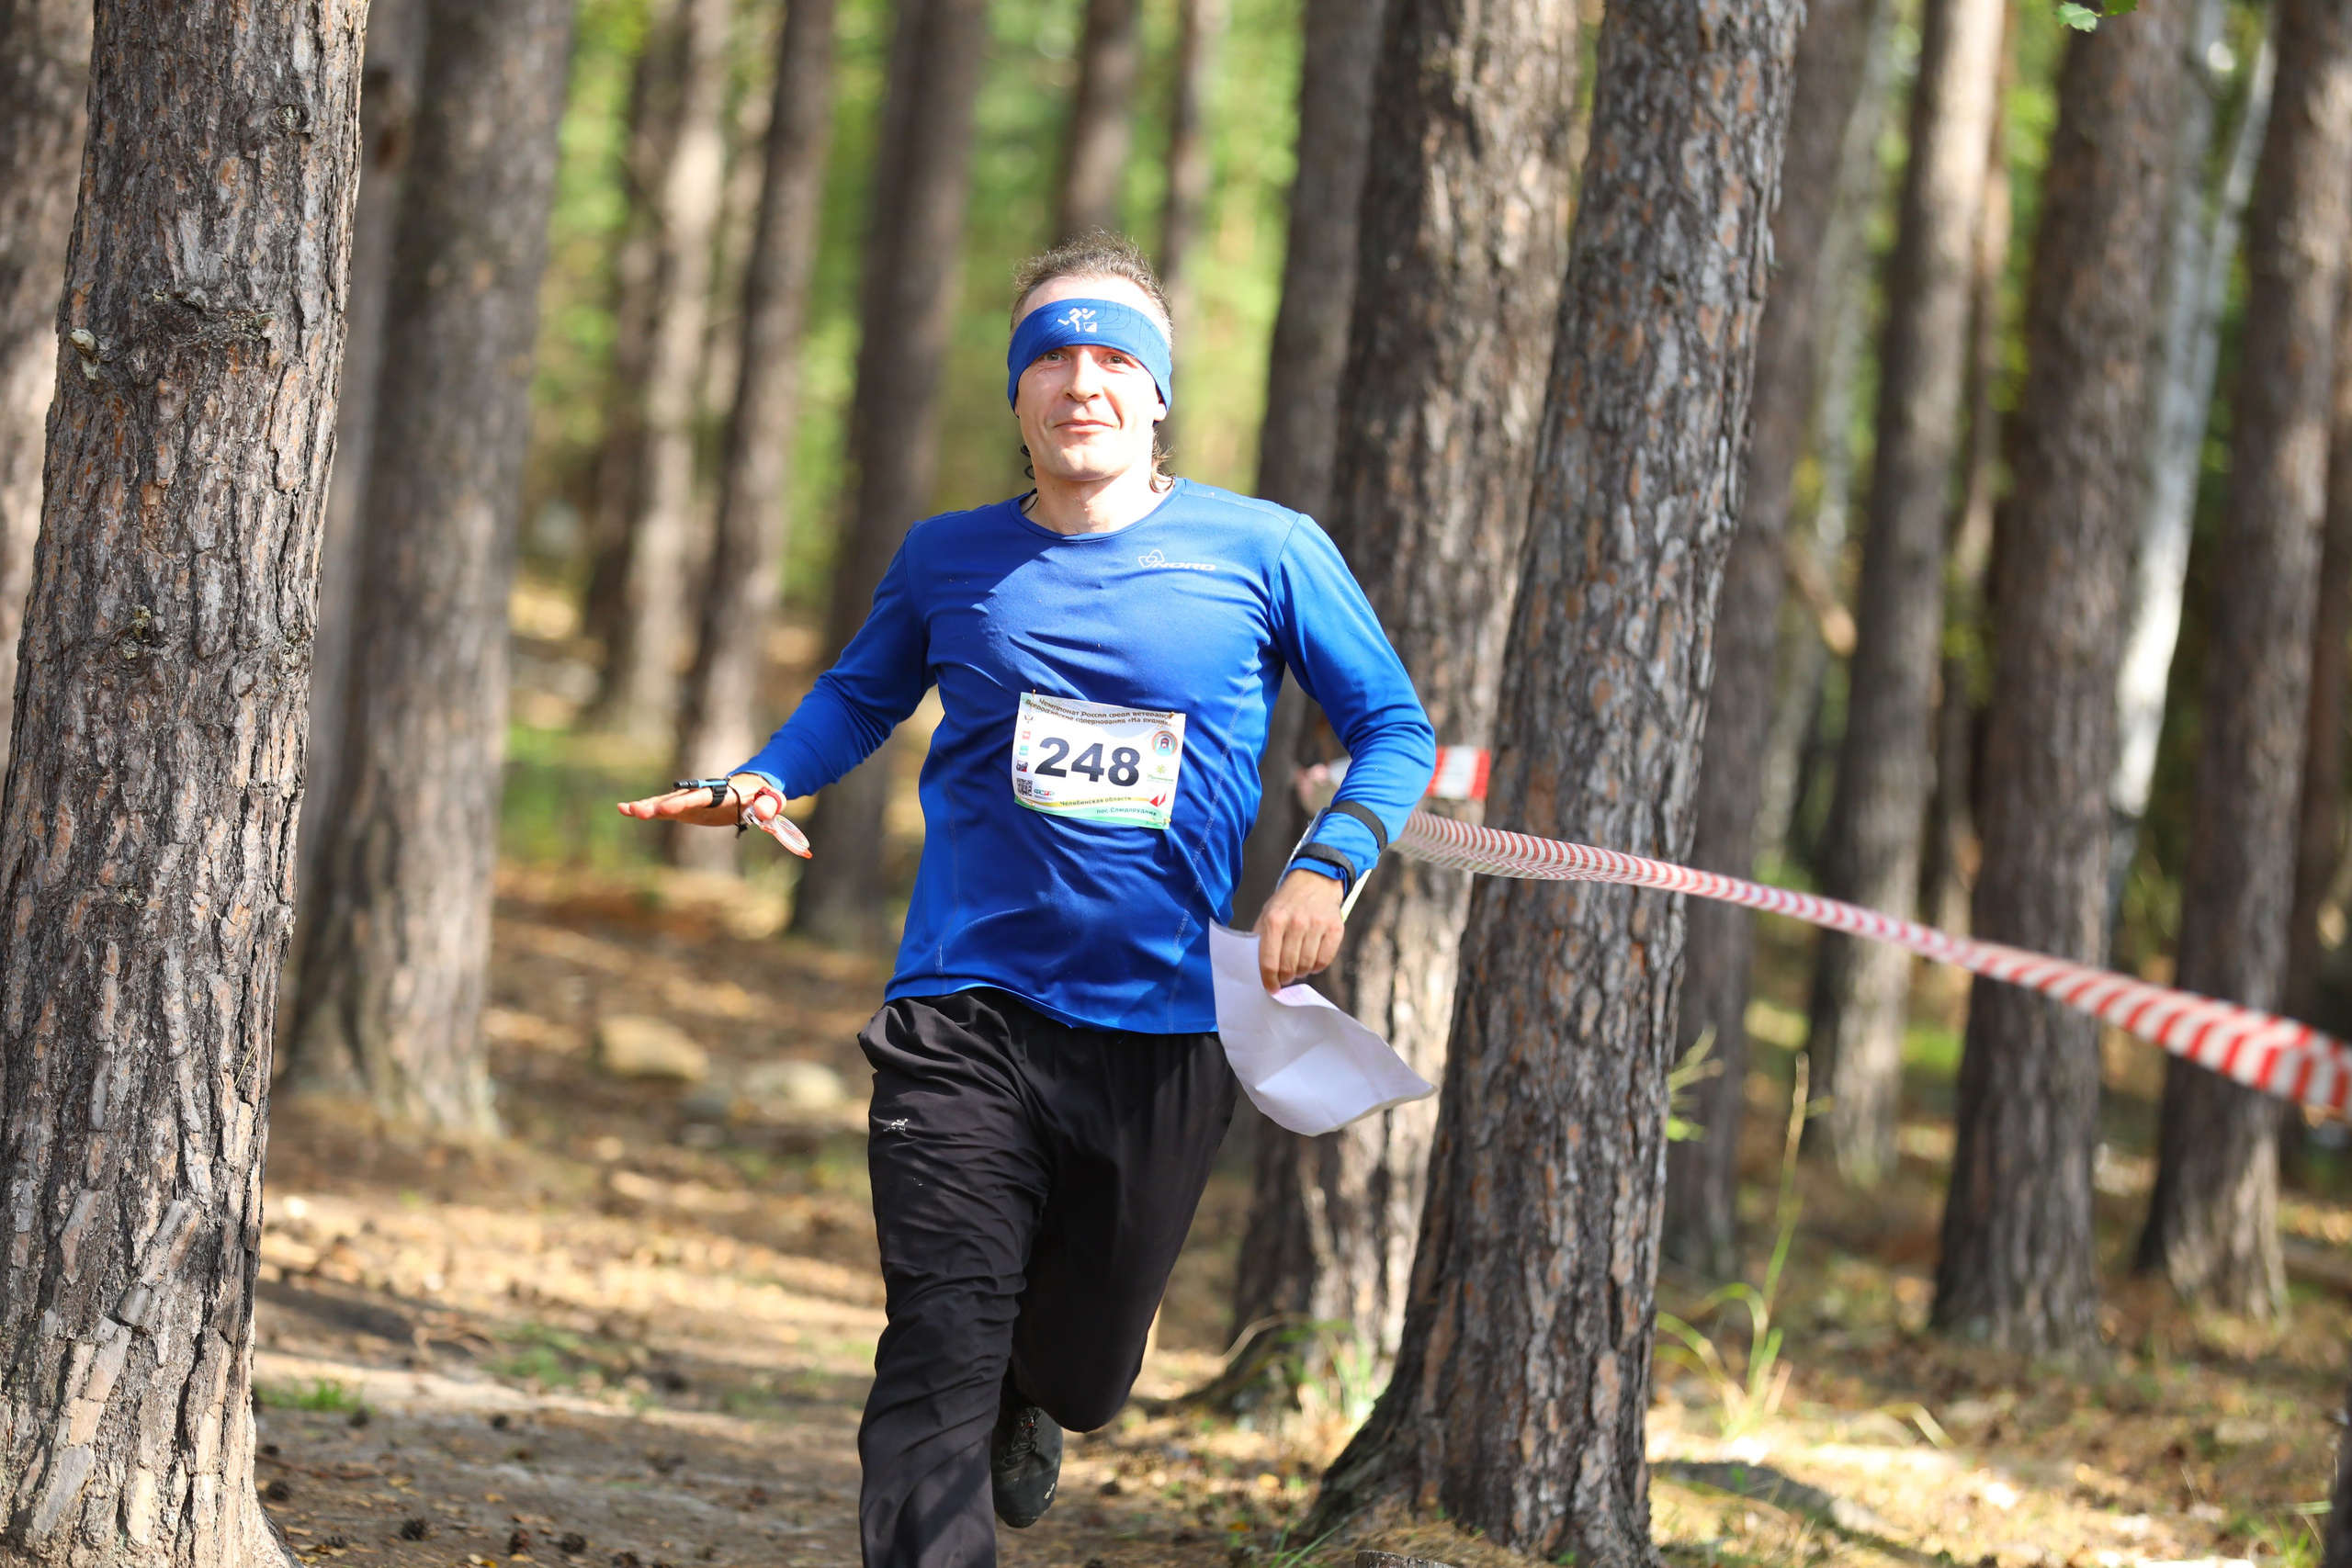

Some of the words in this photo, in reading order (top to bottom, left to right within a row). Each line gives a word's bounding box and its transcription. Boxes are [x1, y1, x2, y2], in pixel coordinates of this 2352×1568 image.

[1152, 562, 1216, 570] NORD
[1039, 698, 1080, 716] Чемпионат
[1133, 711, 1172, 720] ветерано
[1035, 737, 1140, 786] 248
[1060, 797, 1103, 807] Челябинская
